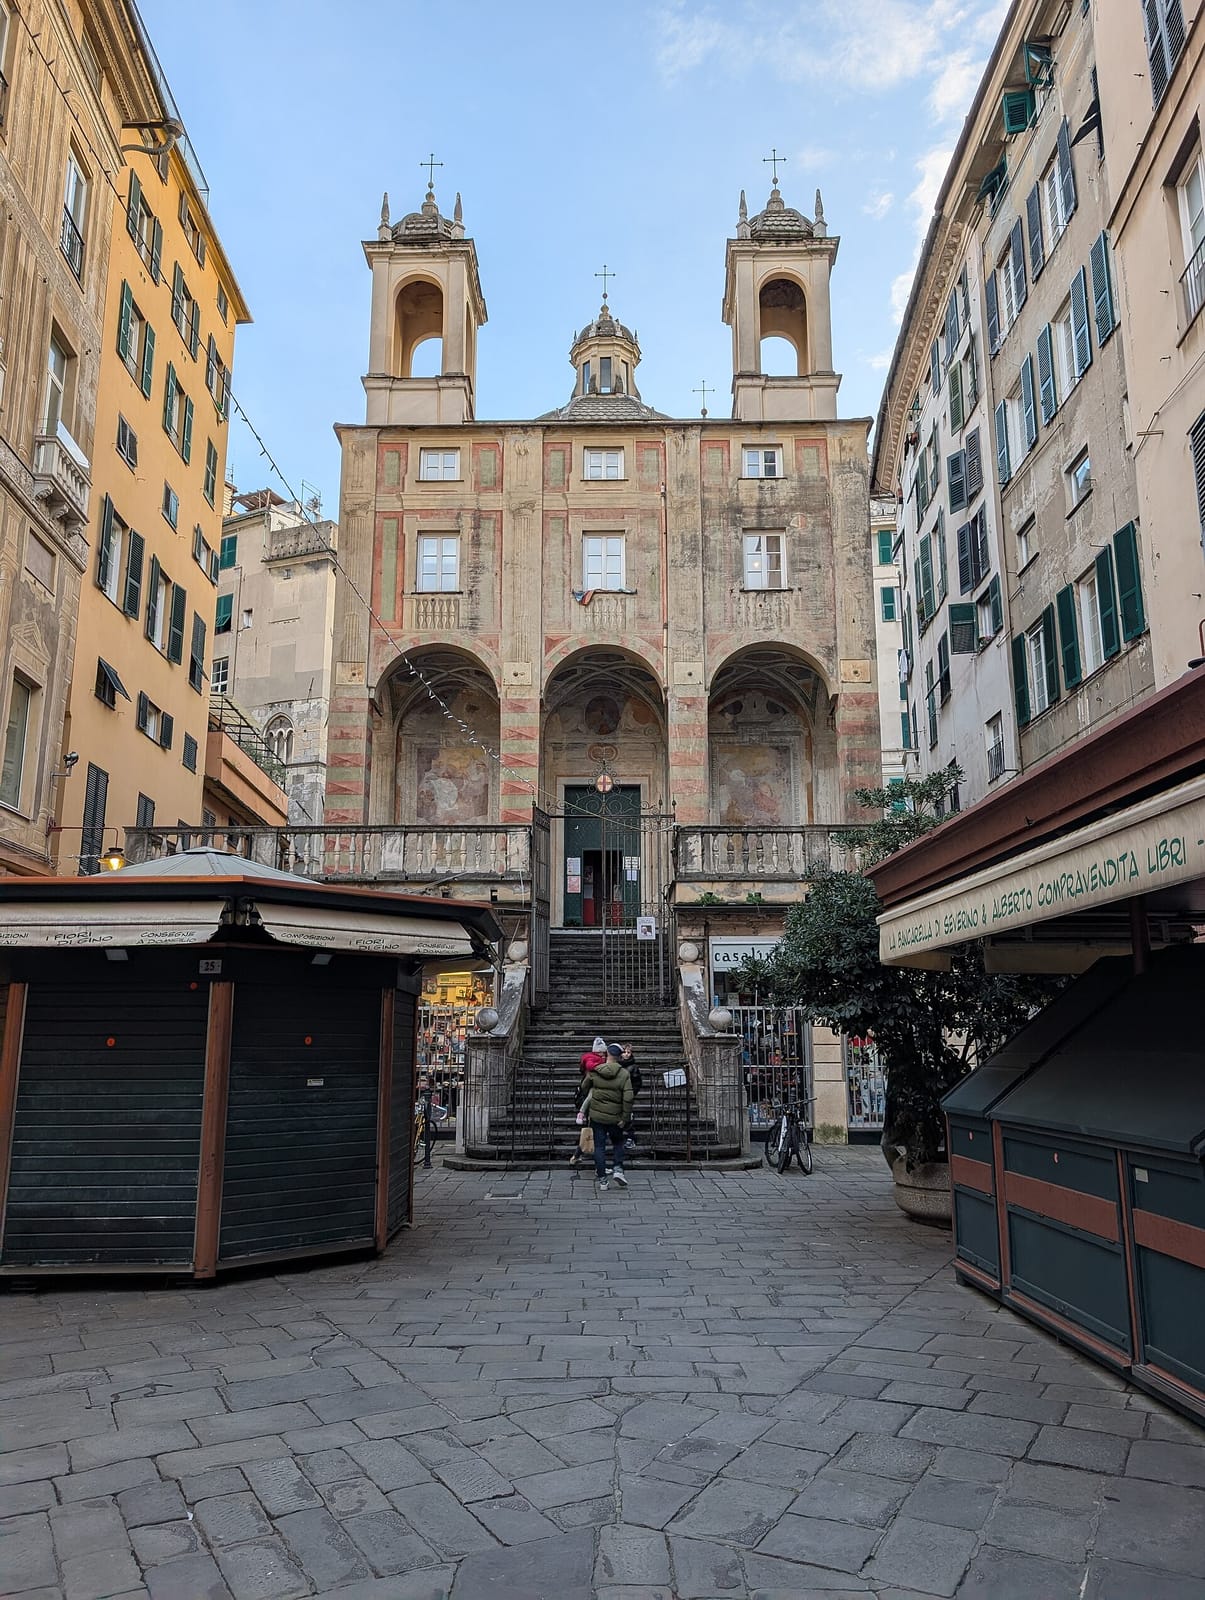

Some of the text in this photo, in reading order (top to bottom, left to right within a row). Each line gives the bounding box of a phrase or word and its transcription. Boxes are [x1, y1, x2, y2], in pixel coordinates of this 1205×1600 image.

[889, 934, 896, 950] LA
[897, 921, 933, 949] BANCARELLA
[935, 919, 941, 937] DI
[943, 907, 979, 935] SEVERINO
[981, 903, 987, 926] &
[992, 887, 1033, 923] ALBERTO
[1037, 850, 1140, 907] COMPRAVENDITA
[1147, 836, 1187, 874] LIBRI
[54, 931, 92, 941] FIORI
[77, 935, 113, 945] GINO
[280, 932, 336, 942] COMPOSIZIONI
[355, 938, 385, 946] FIORI
[417, 942, 457, 950] CONSEGNE
